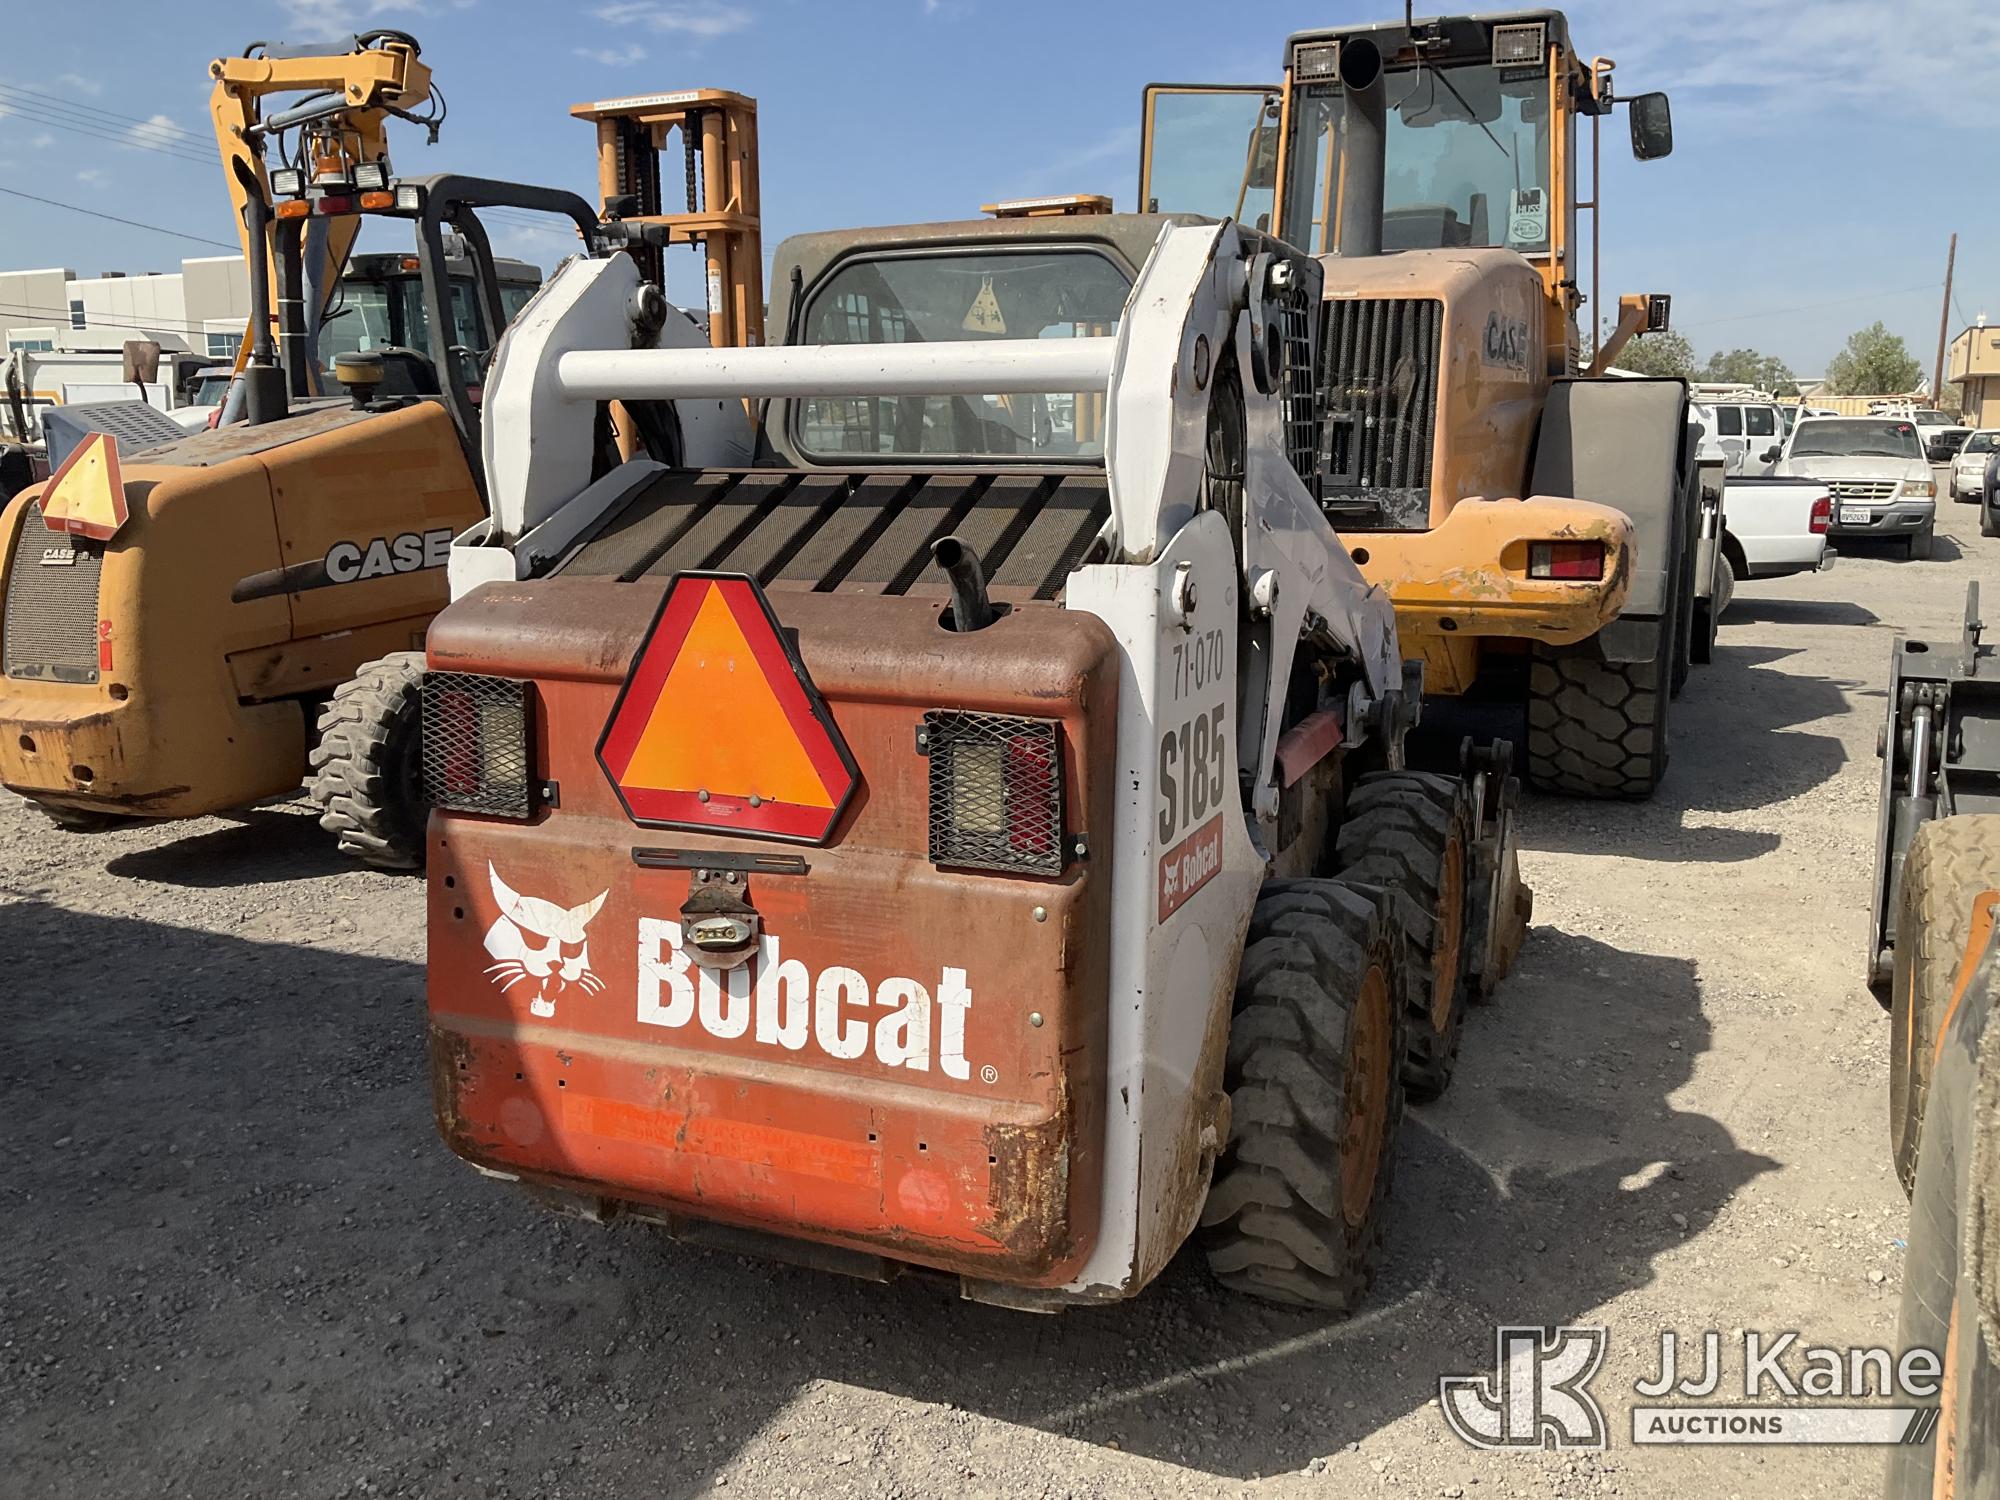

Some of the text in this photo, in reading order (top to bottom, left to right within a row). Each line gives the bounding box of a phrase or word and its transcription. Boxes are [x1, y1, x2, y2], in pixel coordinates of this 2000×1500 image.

[42, 548, 76, 559] CASE
[325, 528, 453, 583] CASE
[1173, 629, 1224, 700] 71-070
[1159, 702, 1225, 846] S185
[1182, 831, 1218, 894] Bobcat
[637, 917, 972, 1080] Bobcat
